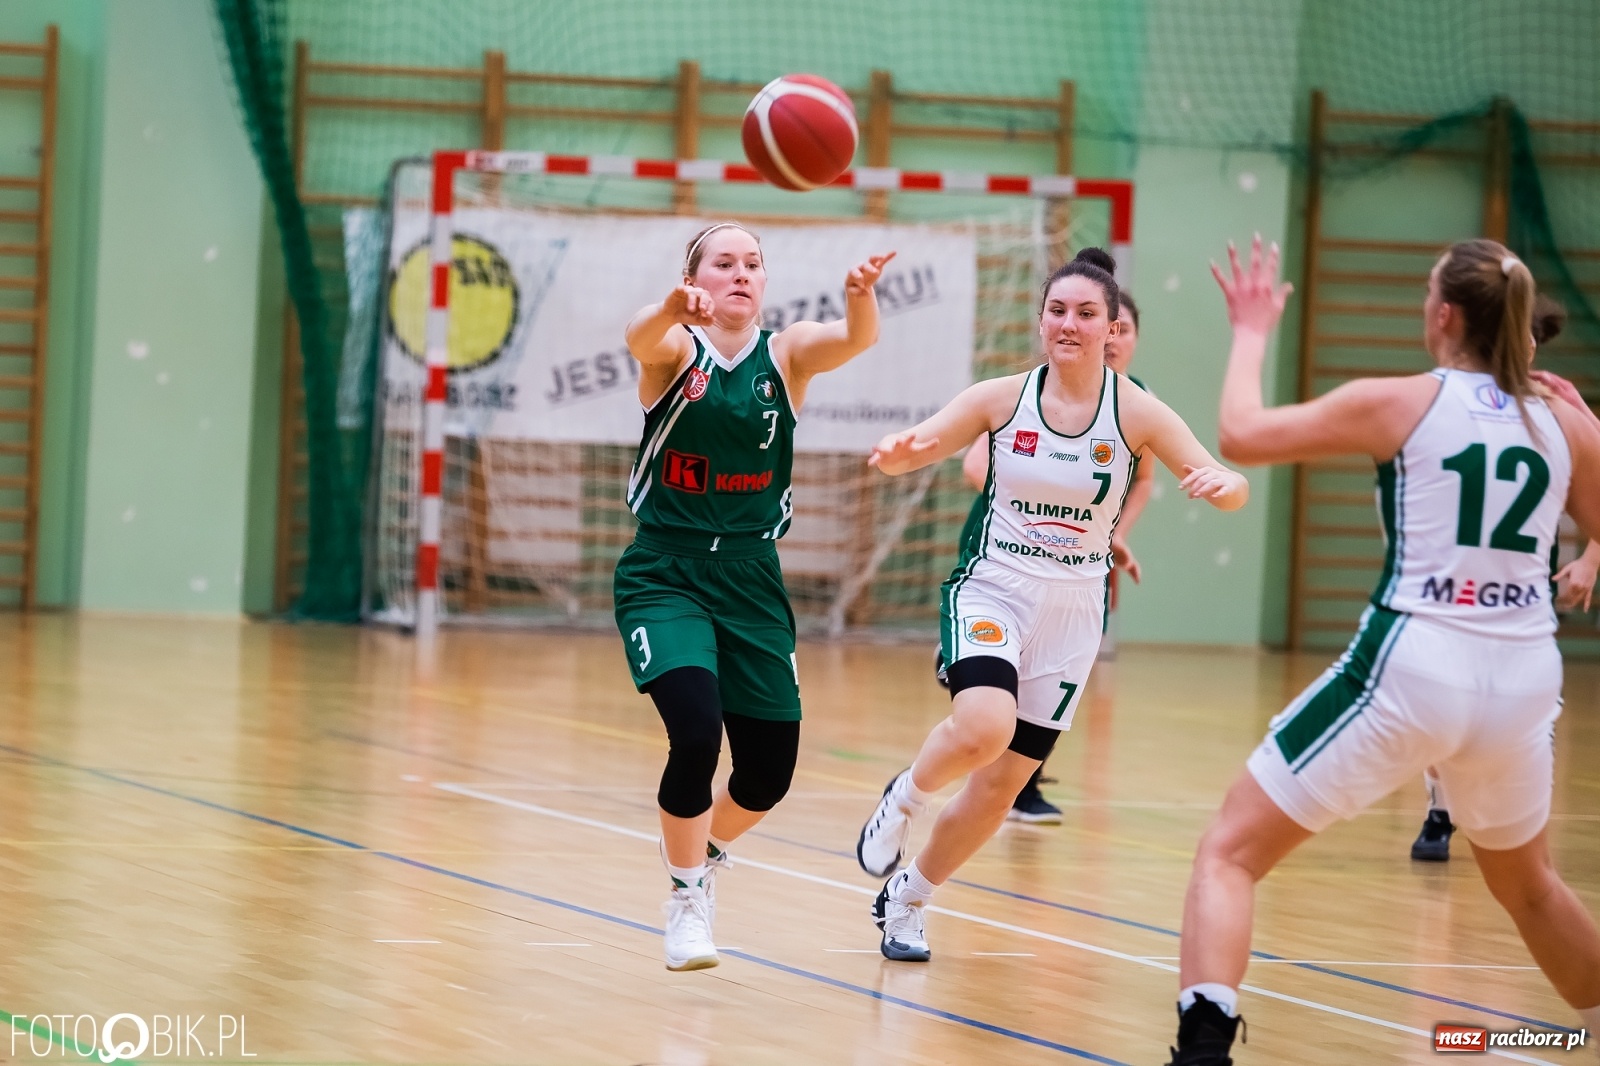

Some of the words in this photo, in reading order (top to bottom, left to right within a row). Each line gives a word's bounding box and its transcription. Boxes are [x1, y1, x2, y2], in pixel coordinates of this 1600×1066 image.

[759, 410, 779, 449] 3
[1052, 451, 1080, 463] PROTON
[1090, 471, 1112, 506] 7
[1441, 442, 1551, 555] 12
[1010, 499, 1093, 522] OLIMPIA
[630, 626, 652, 672] 3
[1050, 680, 1079, 722] 7
